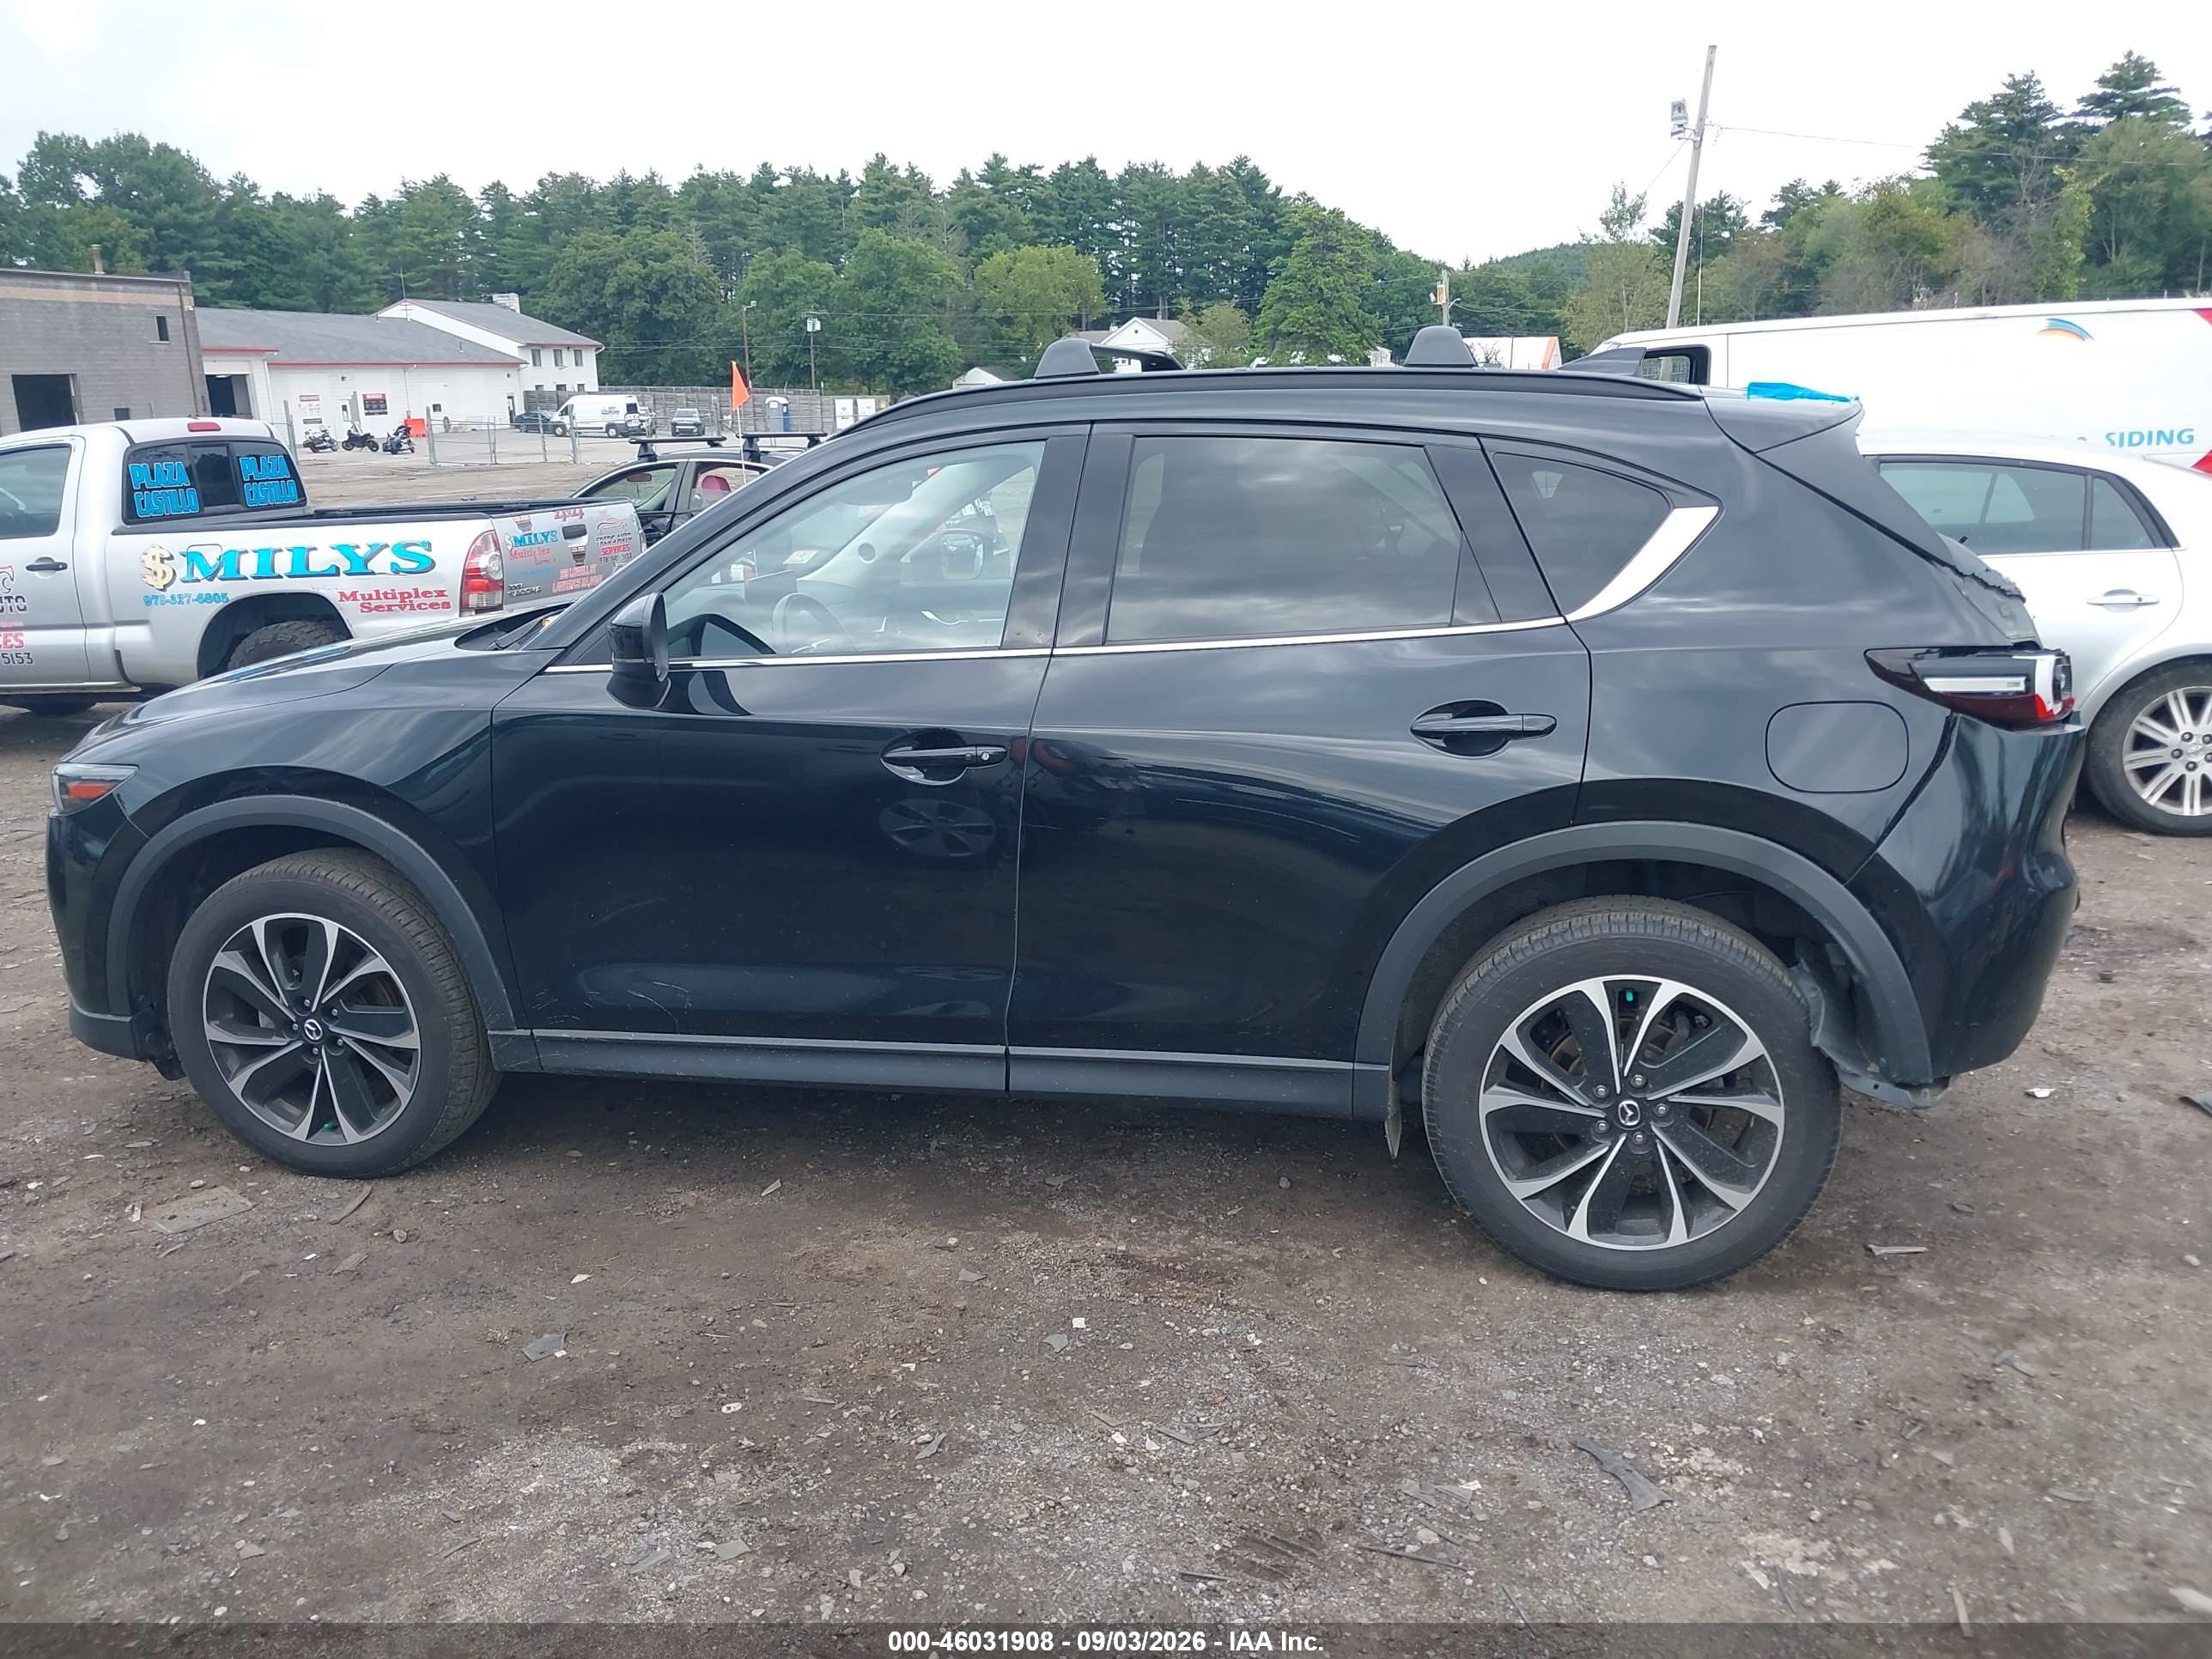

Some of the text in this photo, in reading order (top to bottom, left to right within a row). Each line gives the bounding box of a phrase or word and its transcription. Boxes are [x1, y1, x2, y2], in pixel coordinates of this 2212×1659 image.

[2105, 428, 2195, 447] SIDING
[129, 461, 191, 489] PLAZA
[239, 455, 291, 481] PLAZA
[134, 488, 200, 518] CASTILLO
[244, 480, 298, 507] CASTILLO
[600, 544, 631, 556] SERVICES
[338, 587, 449, 603] Multiplex
[360, 600, 452, 613] Services
